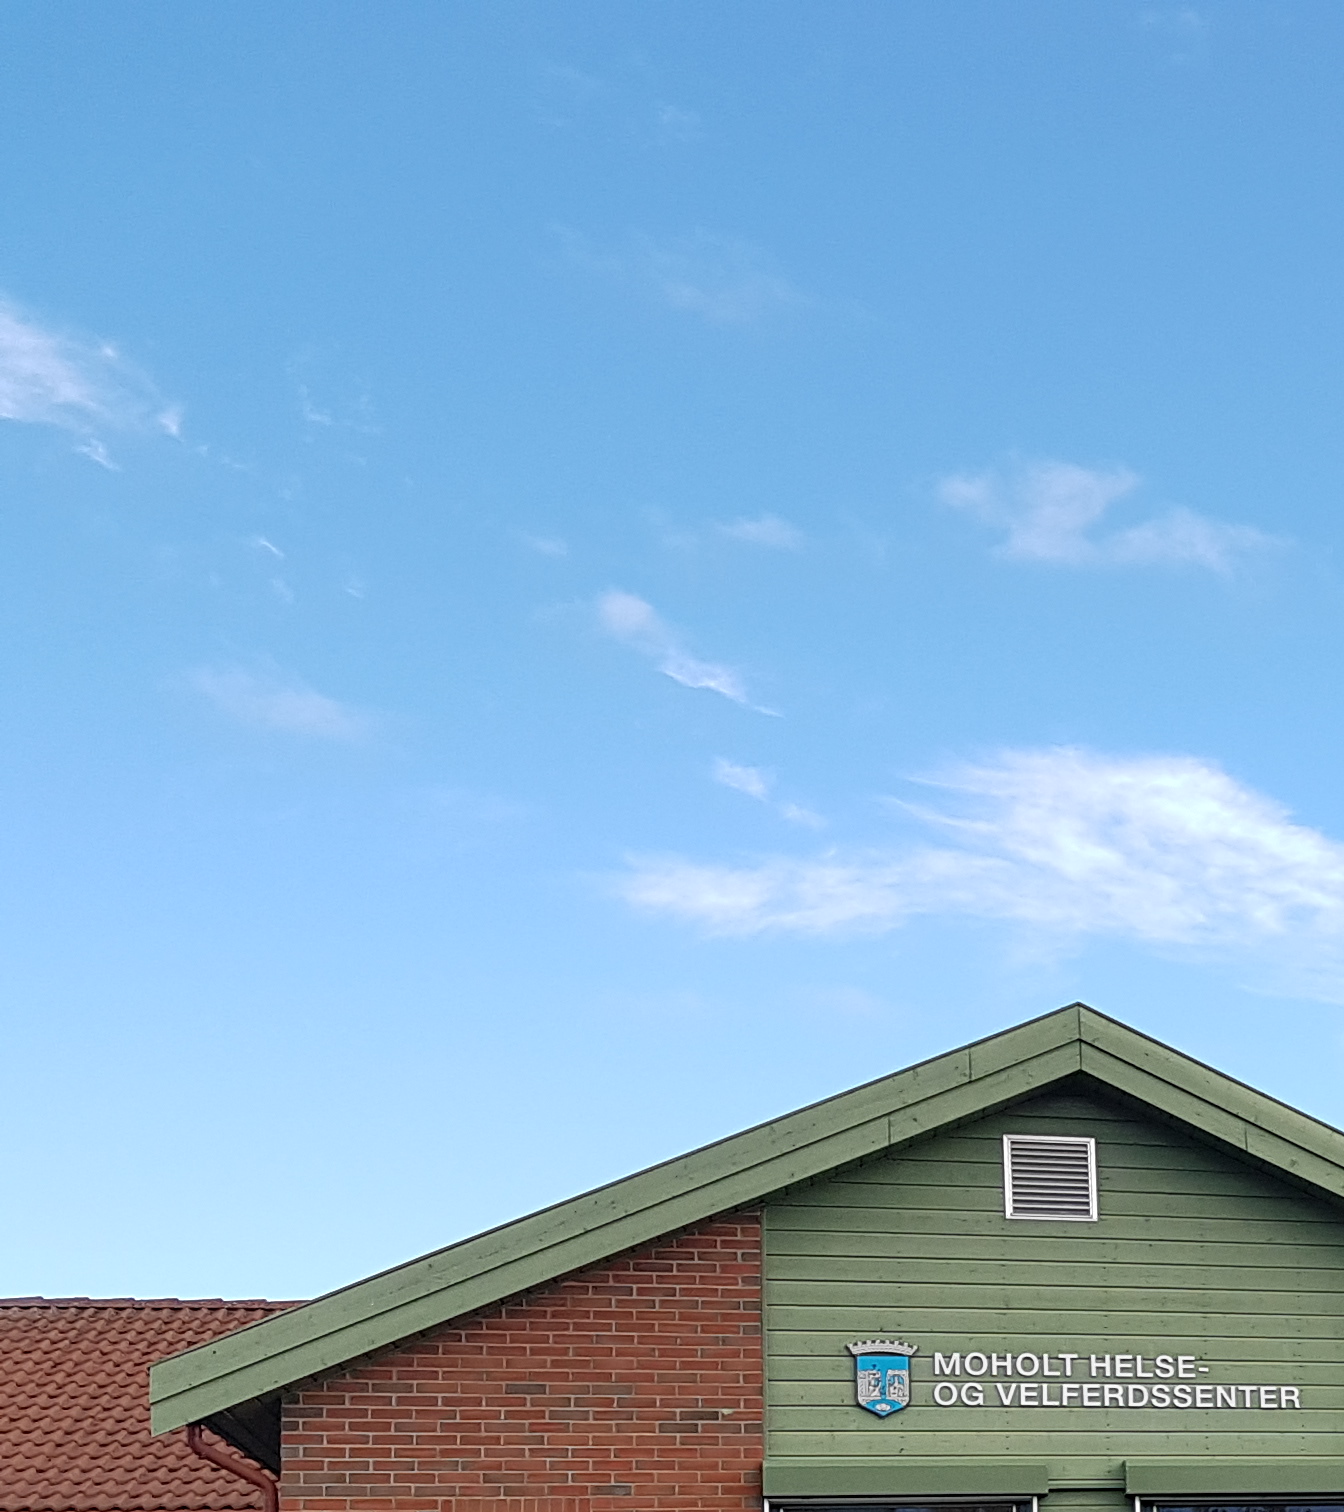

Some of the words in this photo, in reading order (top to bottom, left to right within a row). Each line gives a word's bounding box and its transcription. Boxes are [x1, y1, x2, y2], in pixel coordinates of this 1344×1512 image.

[933, 1351, 1079, 1377] MOHOLT
[1090, 1353, 1209, 1379] HELSE-
[933, 1382, 984, 1406] OG
[996, 1383, 1301, 1409] VELFERDSSENTER
